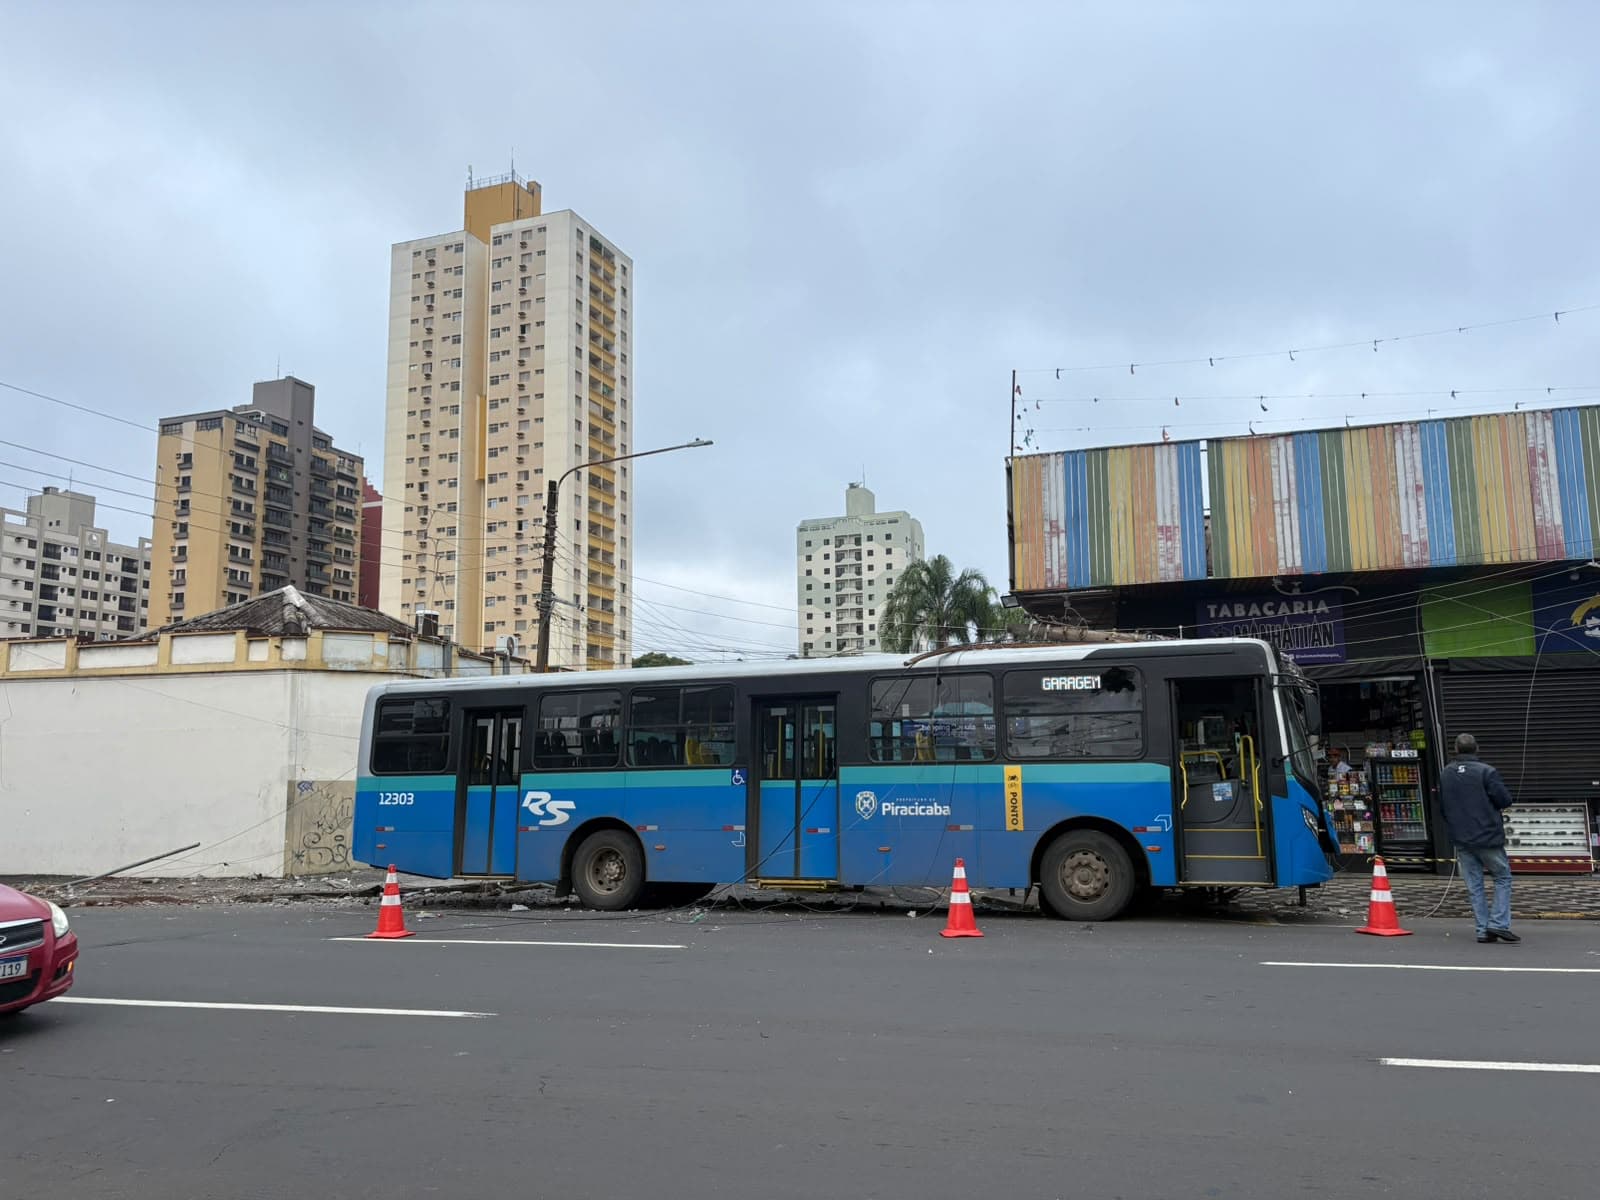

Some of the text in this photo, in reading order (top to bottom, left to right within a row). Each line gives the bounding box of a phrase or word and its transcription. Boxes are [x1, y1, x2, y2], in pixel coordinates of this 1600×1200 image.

[1207, 600, 1330, 618] TABACARIA
[1042, 676, 1101, 691] GARAGEM
[379, 793, 414, 805] 12303
[522, 791, 576, 826] RS
[882, 802, 951, 816] Piracicaba
[1010, 791, 1019, 826] PONTO
[0, 963, 21, 978] I19
